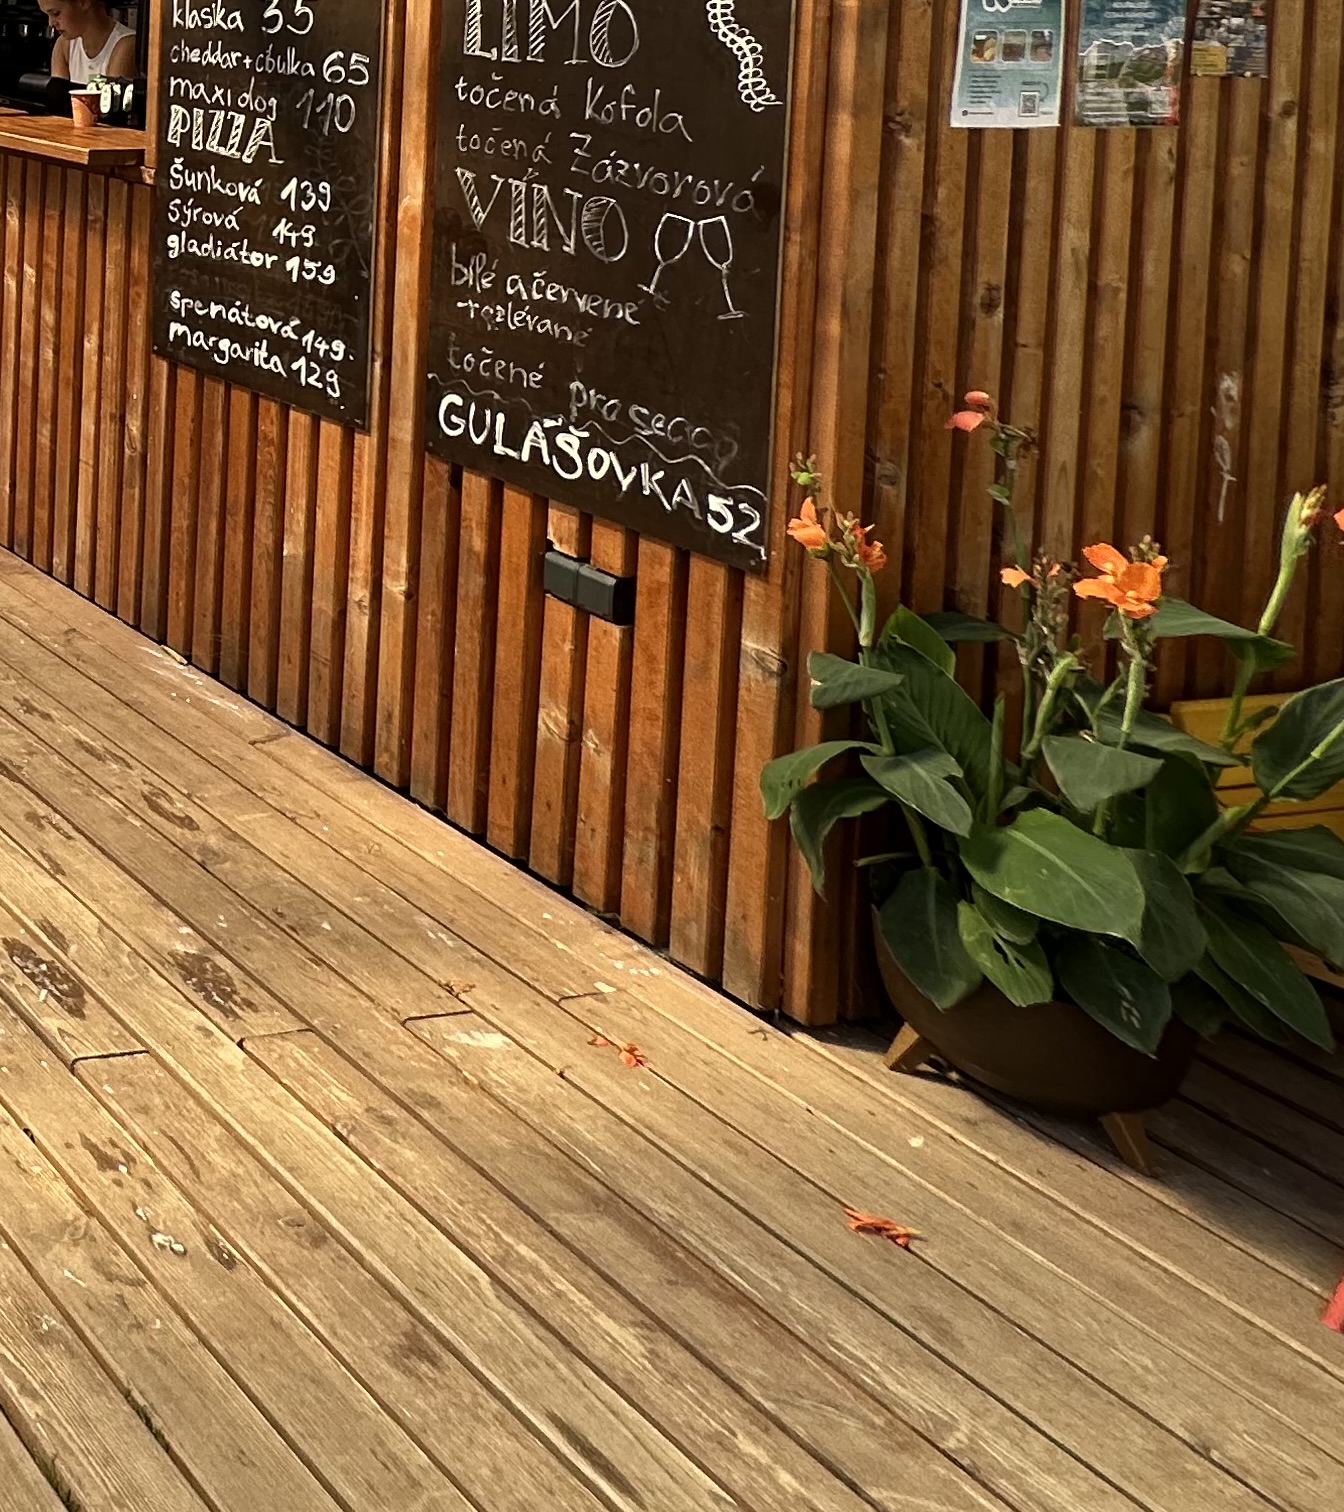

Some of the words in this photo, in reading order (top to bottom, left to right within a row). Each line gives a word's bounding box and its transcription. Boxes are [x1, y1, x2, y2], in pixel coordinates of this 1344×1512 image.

[322, 50, 370, 86] 65
[167, 103, 285, 165] PIZZA
[169, 75, 231, 105] maxi
[237, 76, 278, 121] dog
[295, 88, 356, 137] 110
[454, 75, 562, 118] točená
[585, 78, 693, 143] Kofola
[455, 123, 552, 165] točená
[169, 157, 262, 205] Šunková
[280, 177, 331, 213] 139
[272, 217, 316, 248] 149
[454, 167, 630, 264] VÍNO
[166, 232, 278, 270] gladiátor
[285, 255, 336, 285] 159
[169, 319, 287, 378] margarita
[290, 357, 340, 397] 129
[447, 333, 545, 389] točené
[437, 392, 704, 521] GULÁŠOVKA
